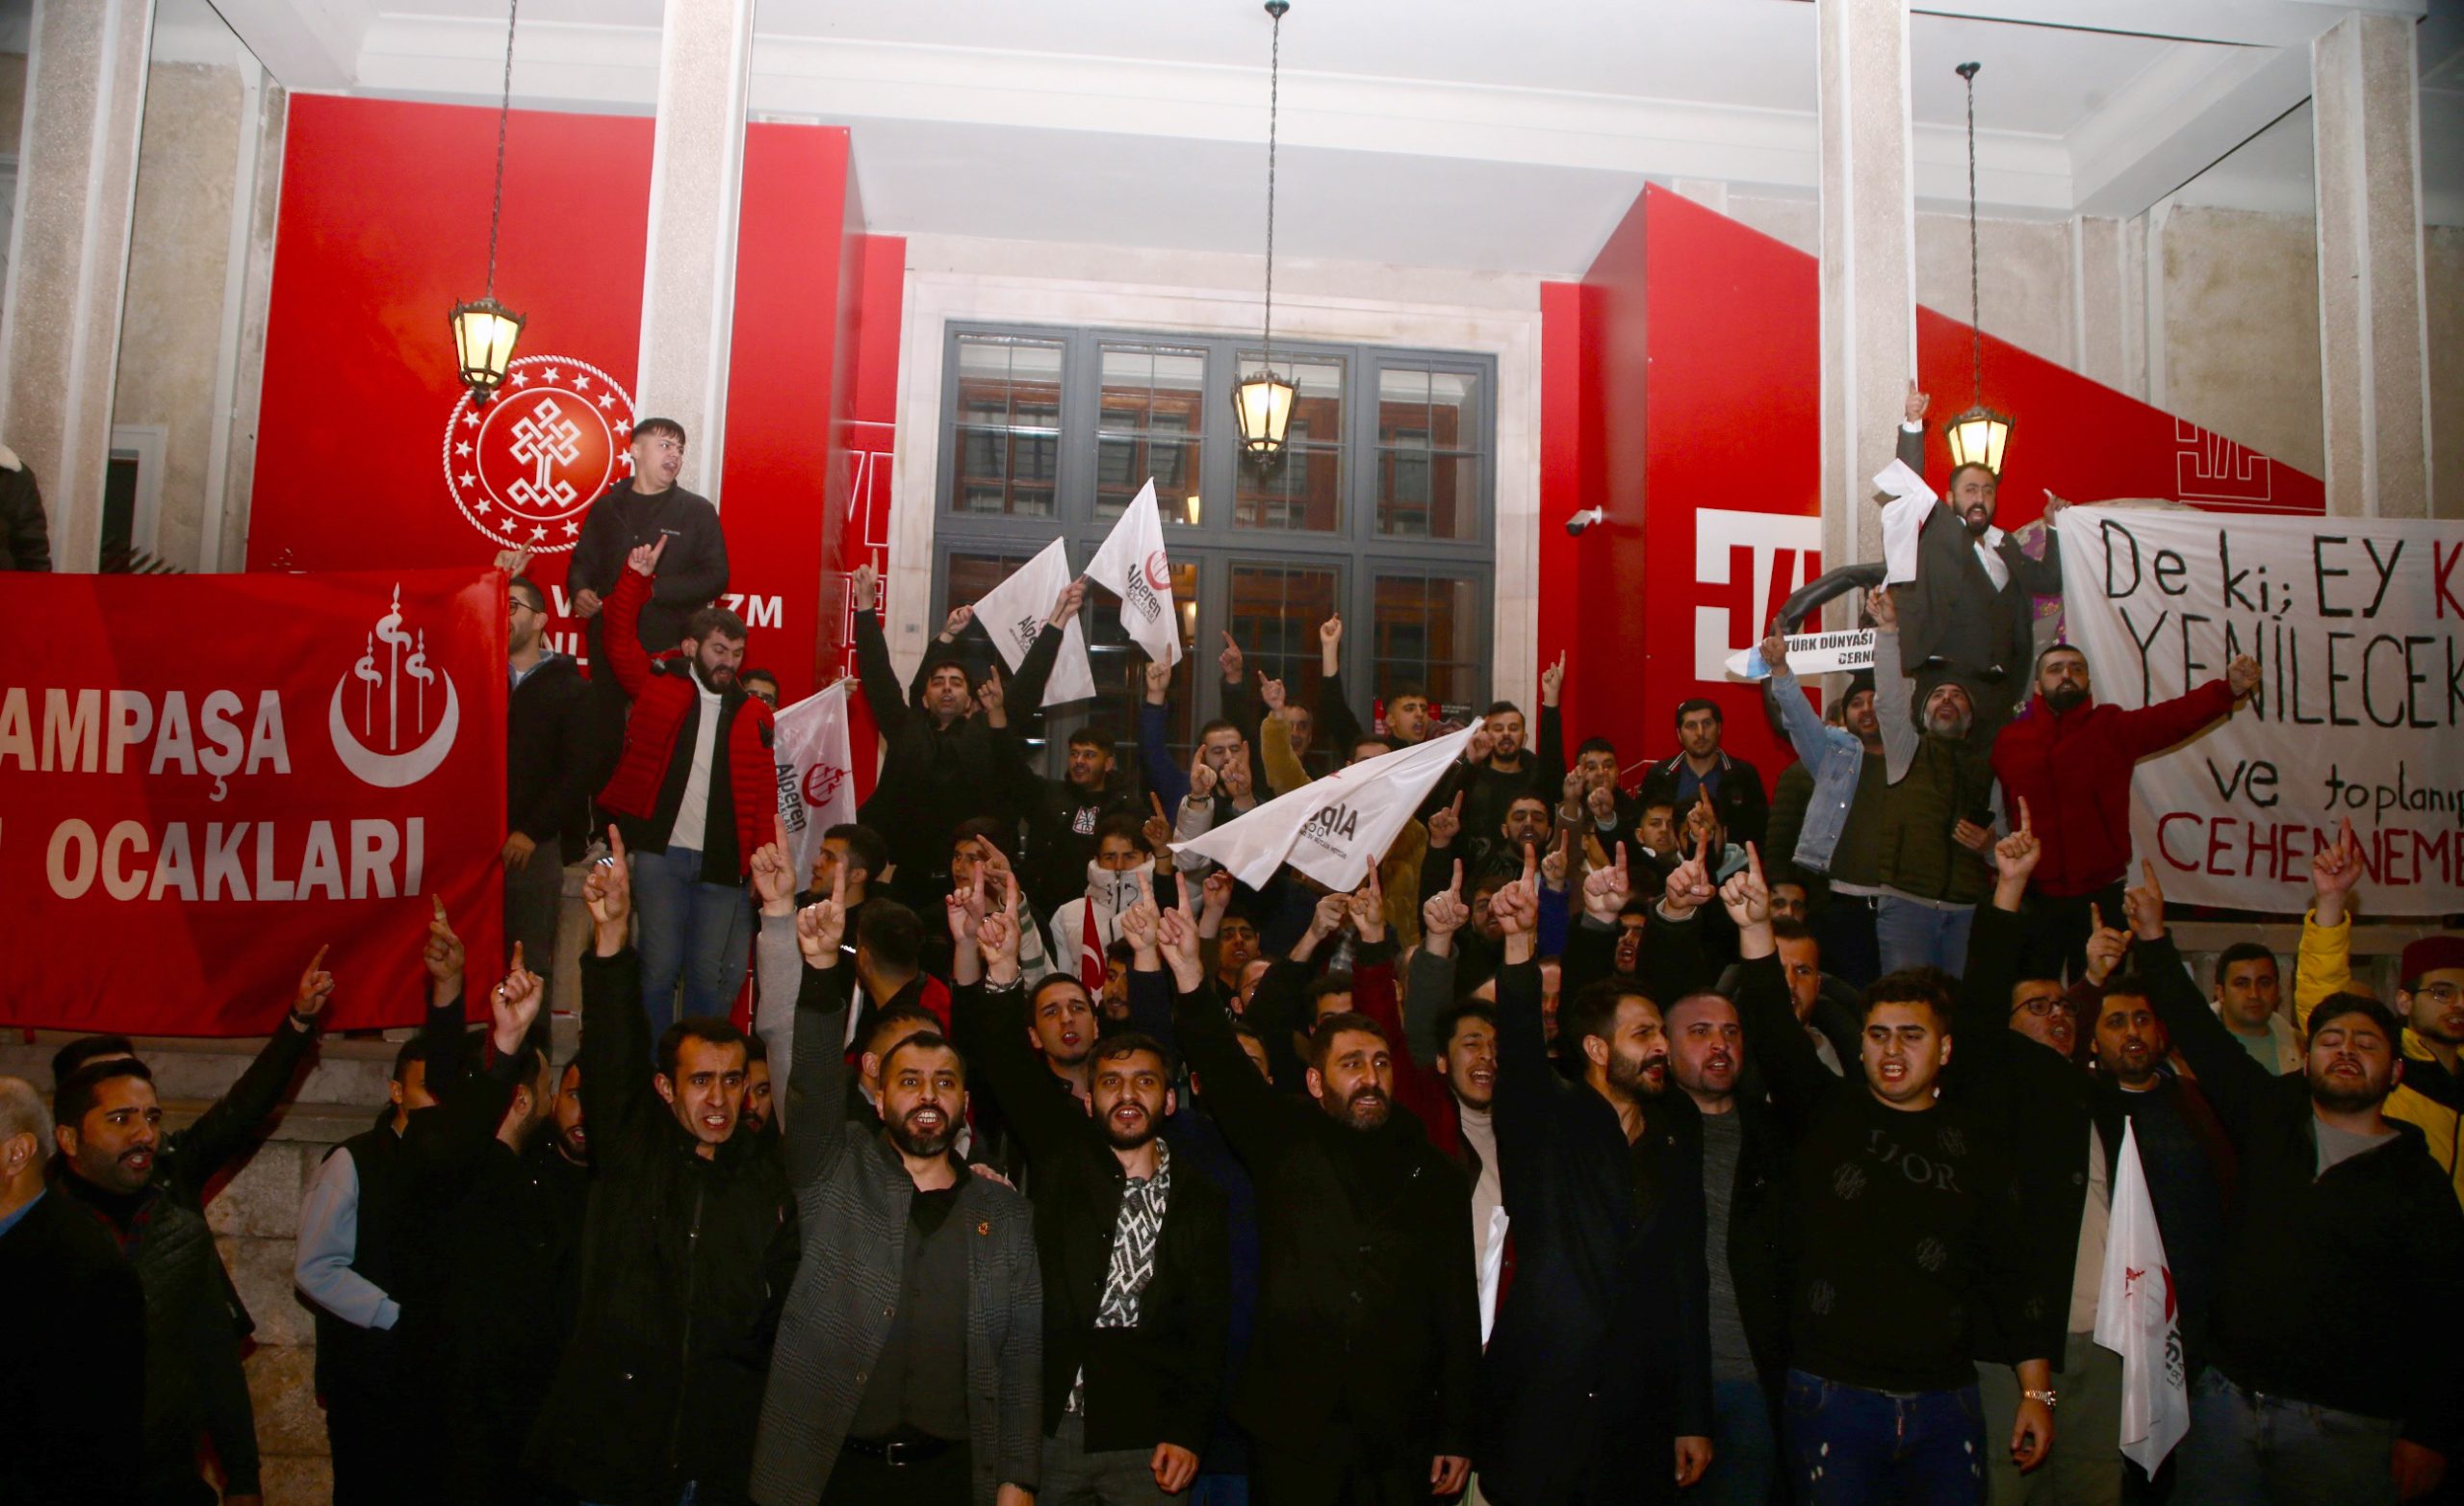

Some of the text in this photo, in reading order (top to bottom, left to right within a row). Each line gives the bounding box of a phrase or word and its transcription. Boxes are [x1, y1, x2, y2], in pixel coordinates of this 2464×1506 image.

[2313, 534, 2404, 618] EY
[0, 687, 292, 802] AMPAŞA
[2207, 757, 2278, 807] ve
[776, 763, 808, 832] Alperen
[46, 816, 424, 902] OCAKLARI
